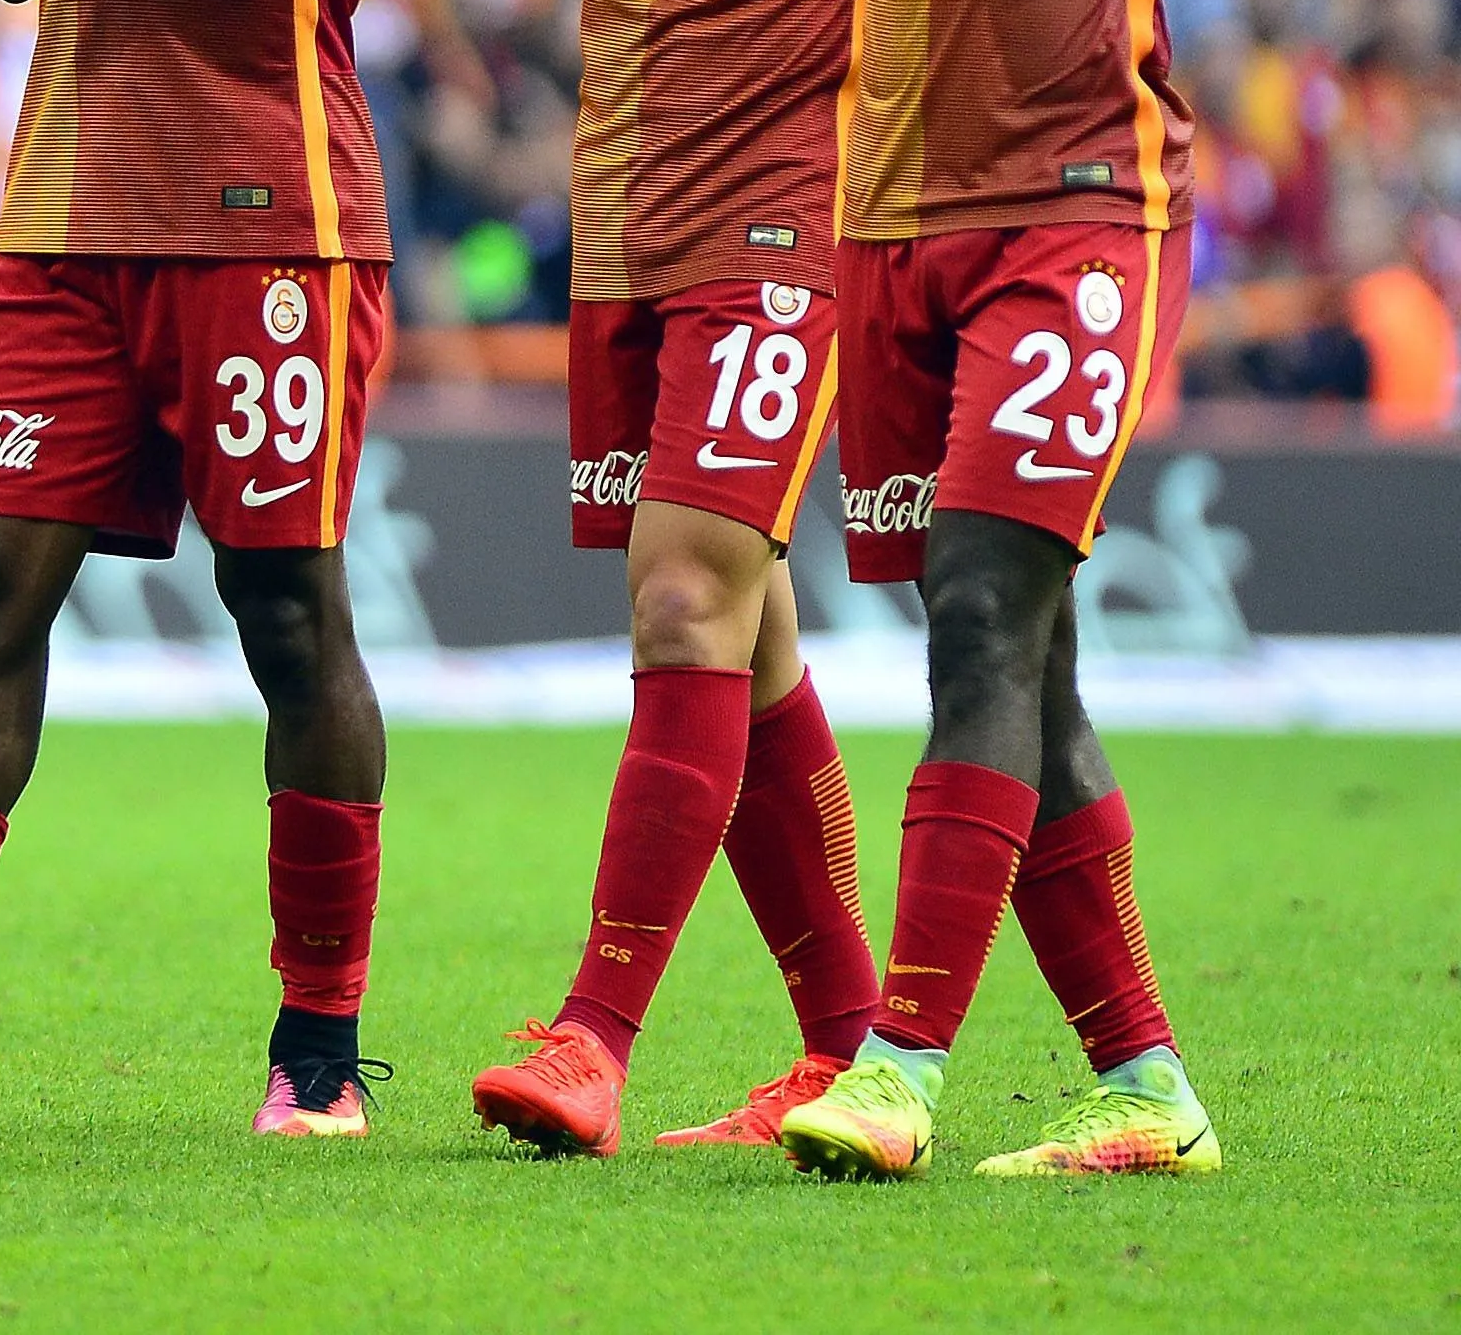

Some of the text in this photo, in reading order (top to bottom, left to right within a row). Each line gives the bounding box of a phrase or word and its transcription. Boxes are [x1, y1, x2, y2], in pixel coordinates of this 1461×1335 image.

[216, 355, 325, 464] 39
[706, 325, 808, 441] 18
[991, 330, 1127, 458] 23
[599, 943, 633, 964] GS
[888, 995, 919, 1015] GS
